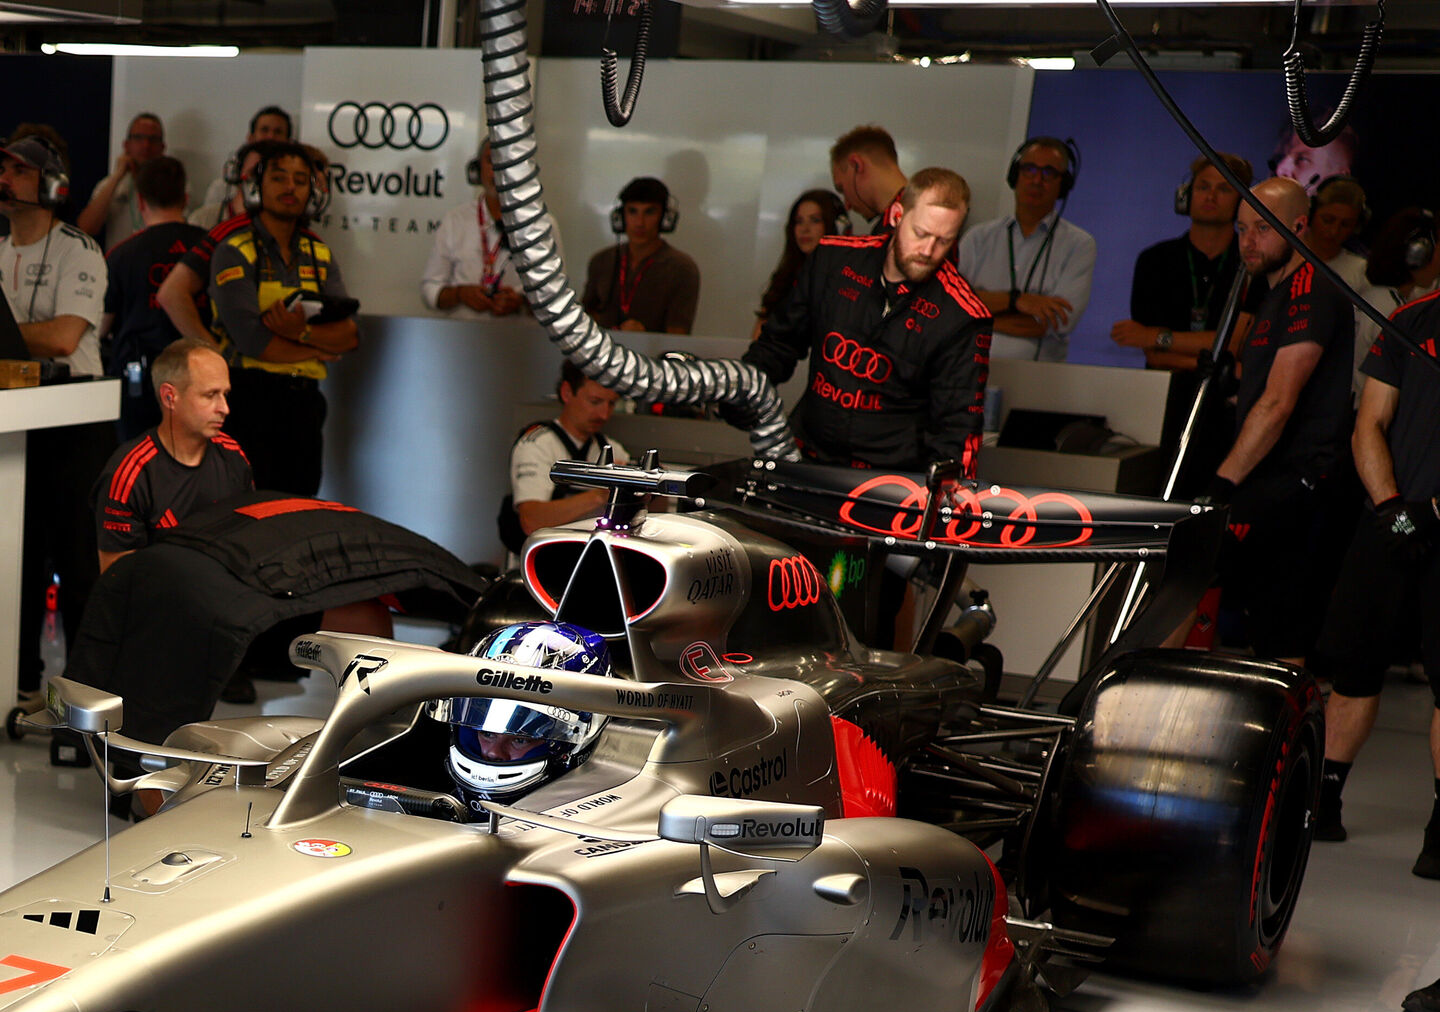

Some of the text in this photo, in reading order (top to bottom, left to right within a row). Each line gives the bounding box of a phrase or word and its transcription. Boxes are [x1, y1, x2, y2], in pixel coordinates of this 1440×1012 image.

[328, 163, 445, 198] Revolut
[372, 216, 441, 233] TEAM
[812, 371, 883, 411] Revolut
[705, 549, 734, 575] visit
[847, 552, 865, 589] bp
[687, 573, 734, 605] QATAR
[476, 668, 553, 694] Gillette
[616, 689, 694, 710] WORLD OF HYATT
[729, 747, 787, 798] Castrol
[560, 793, 623, 818] WORLD OF
[741, 818, 821, 838] Revolut
